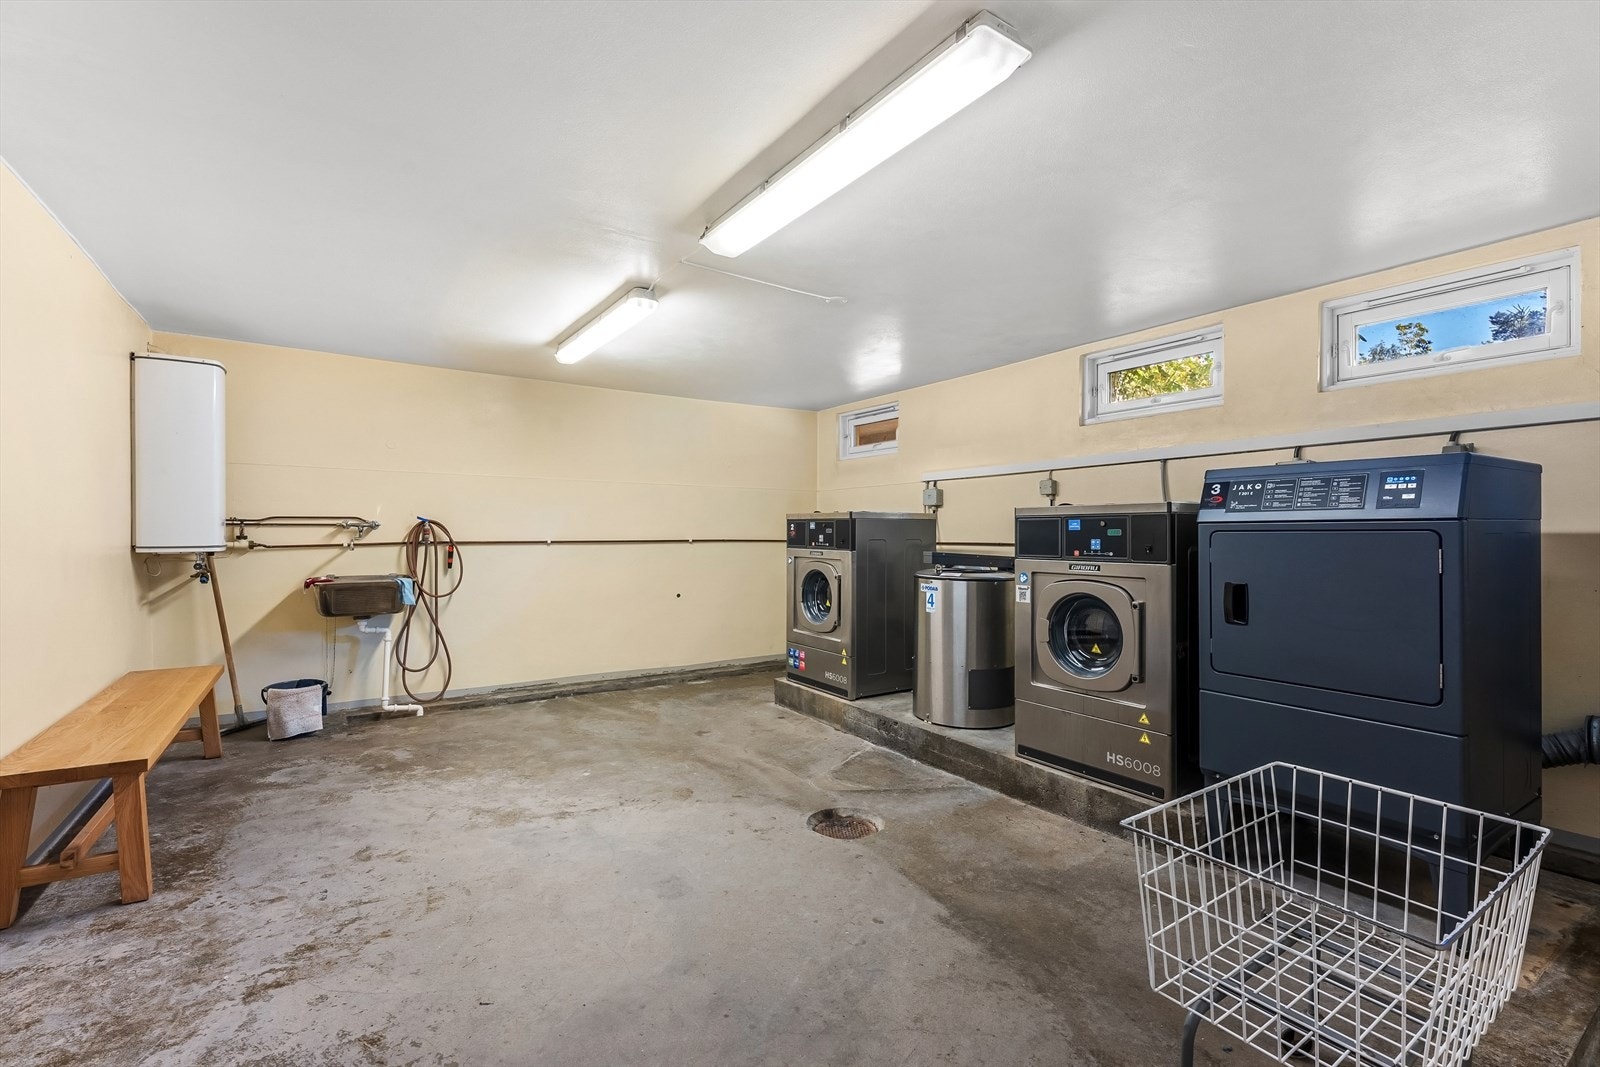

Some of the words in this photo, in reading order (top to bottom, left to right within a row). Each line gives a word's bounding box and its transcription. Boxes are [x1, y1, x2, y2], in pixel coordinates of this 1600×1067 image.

[1210, 483, 1221, 495] 3
[927, 593, 935, 607] 4
[824, 671, 848, 685] HS6008
[1106, 751, 1161, 777] HS6008
